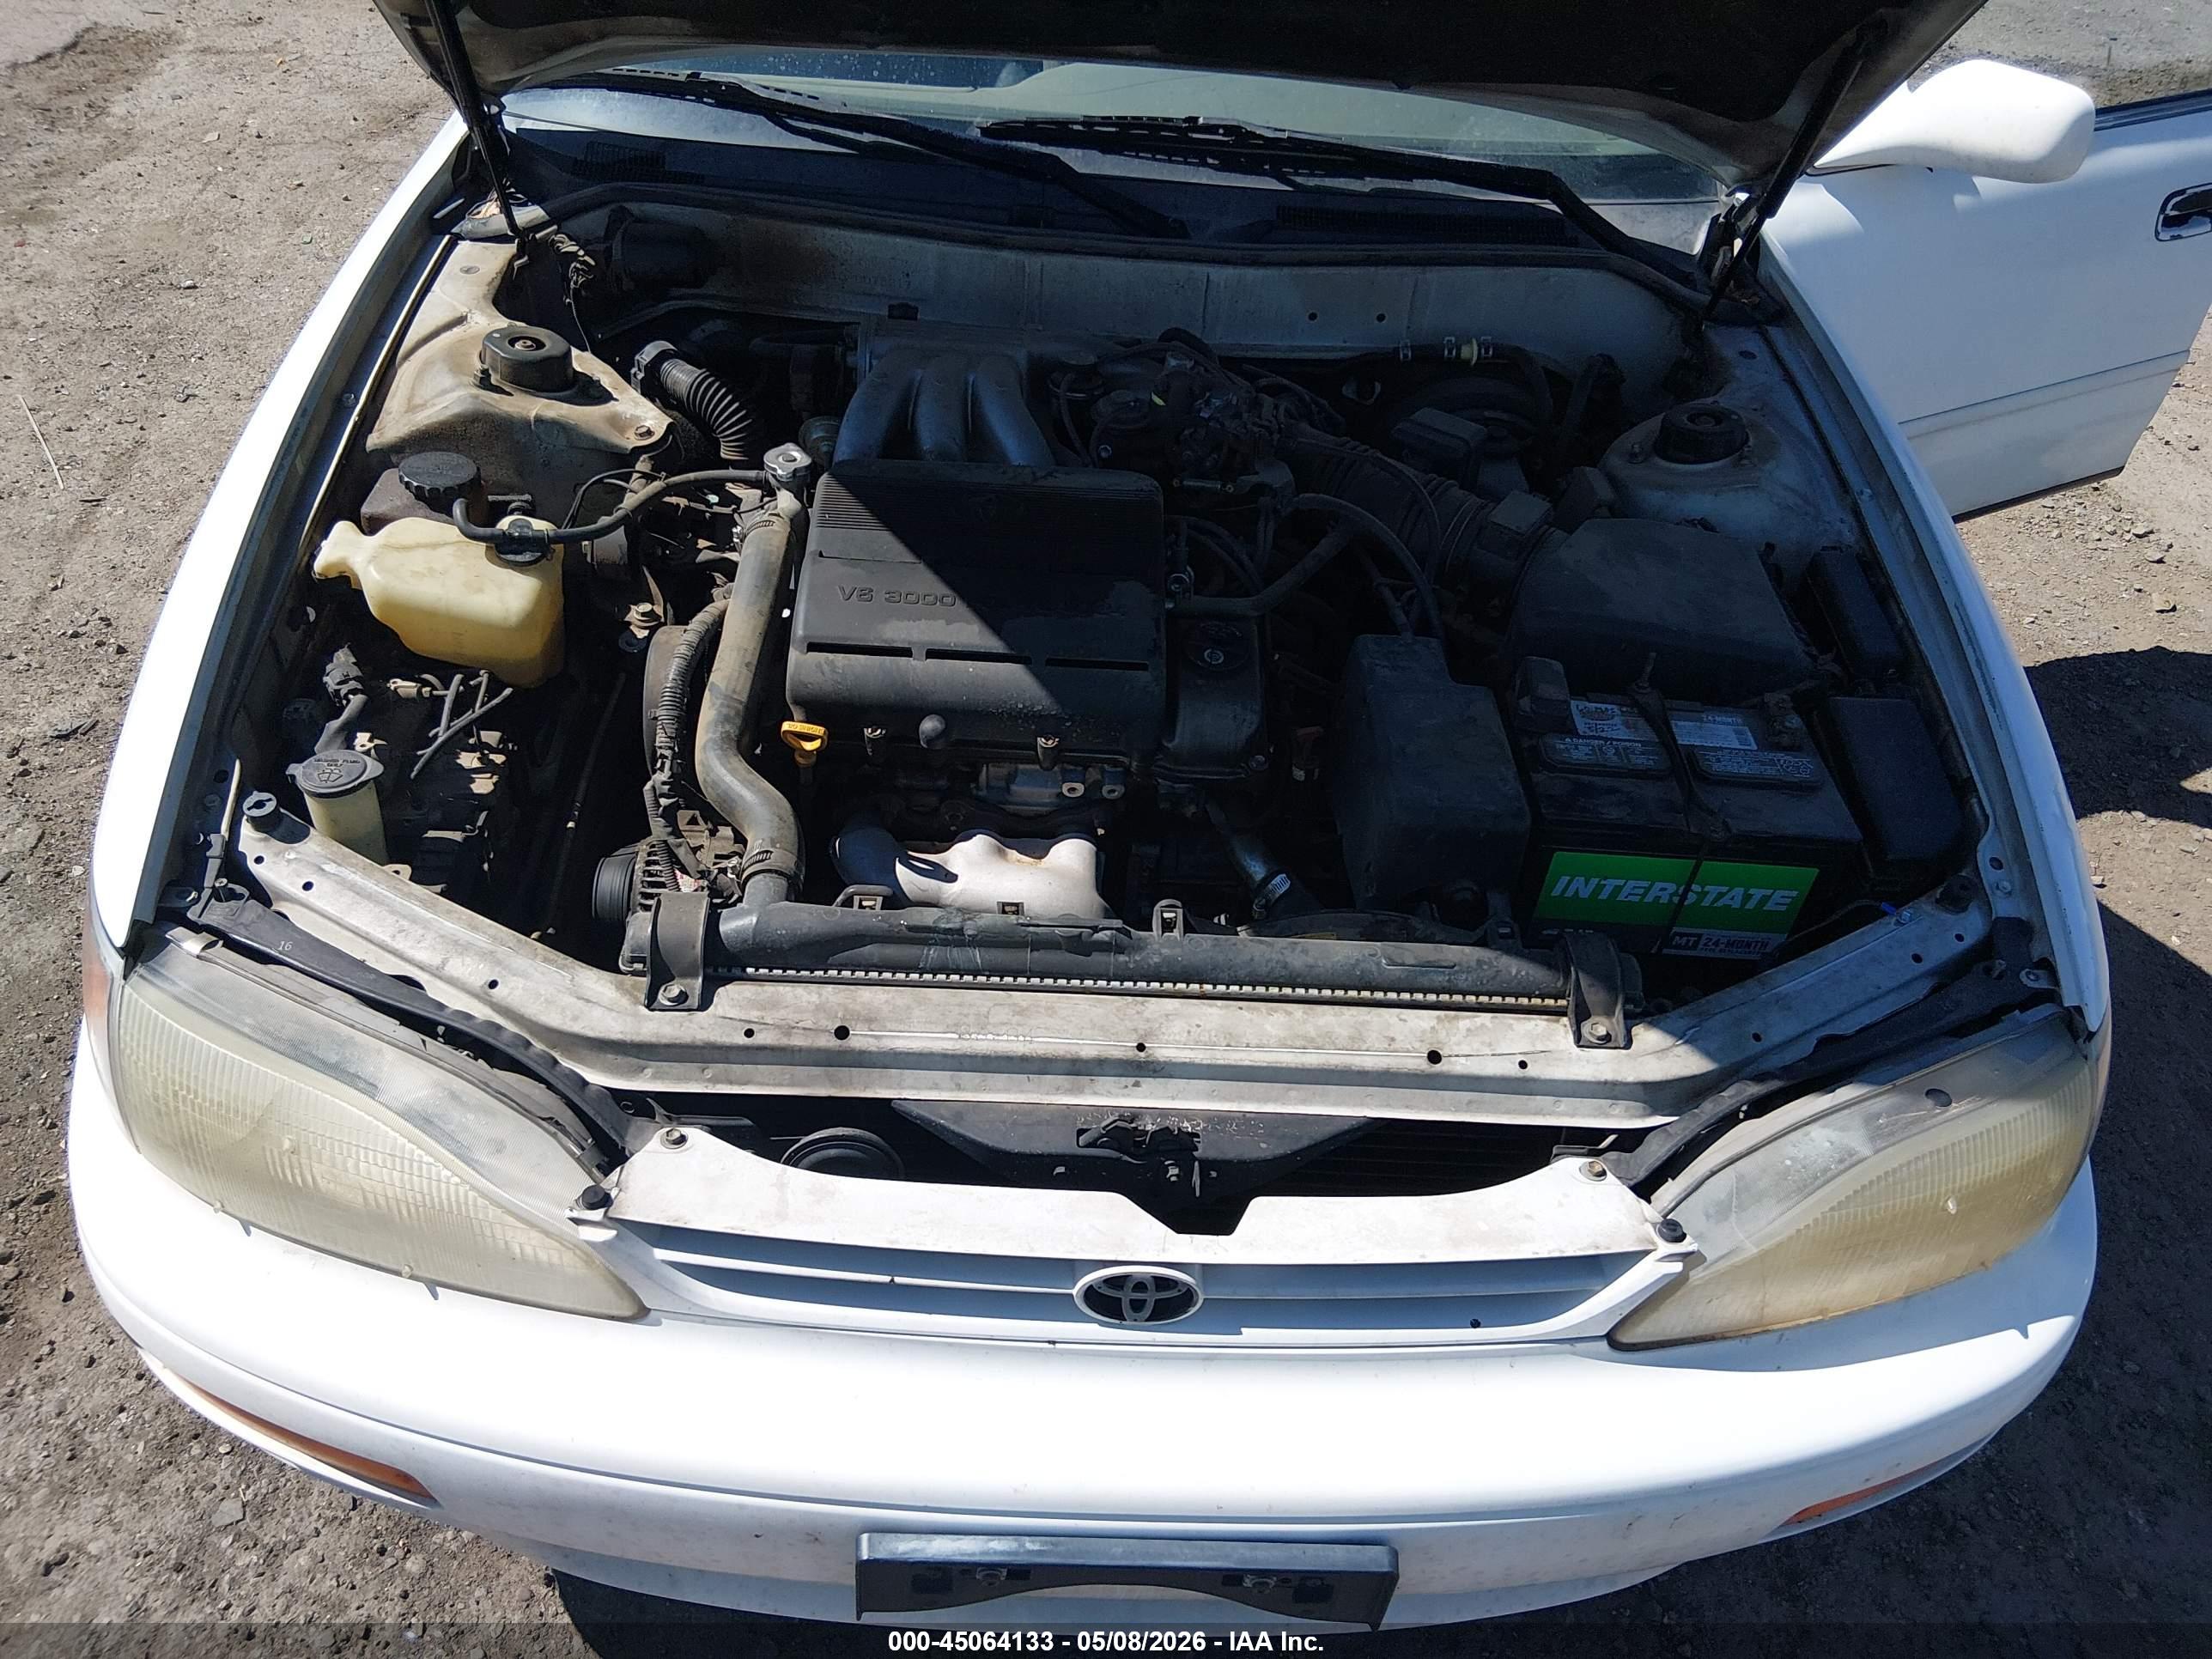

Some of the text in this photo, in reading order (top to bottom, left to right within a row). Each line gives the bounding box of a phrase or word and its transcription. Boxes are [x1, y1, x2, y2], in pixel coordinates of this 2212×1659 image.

[838, 585, 957, 608] V6 3000
[276, 940, 294, 951] 16
[1671, 935, 1698, 948] MT
[1702, 937, 1771, 951] 24-MONTH
